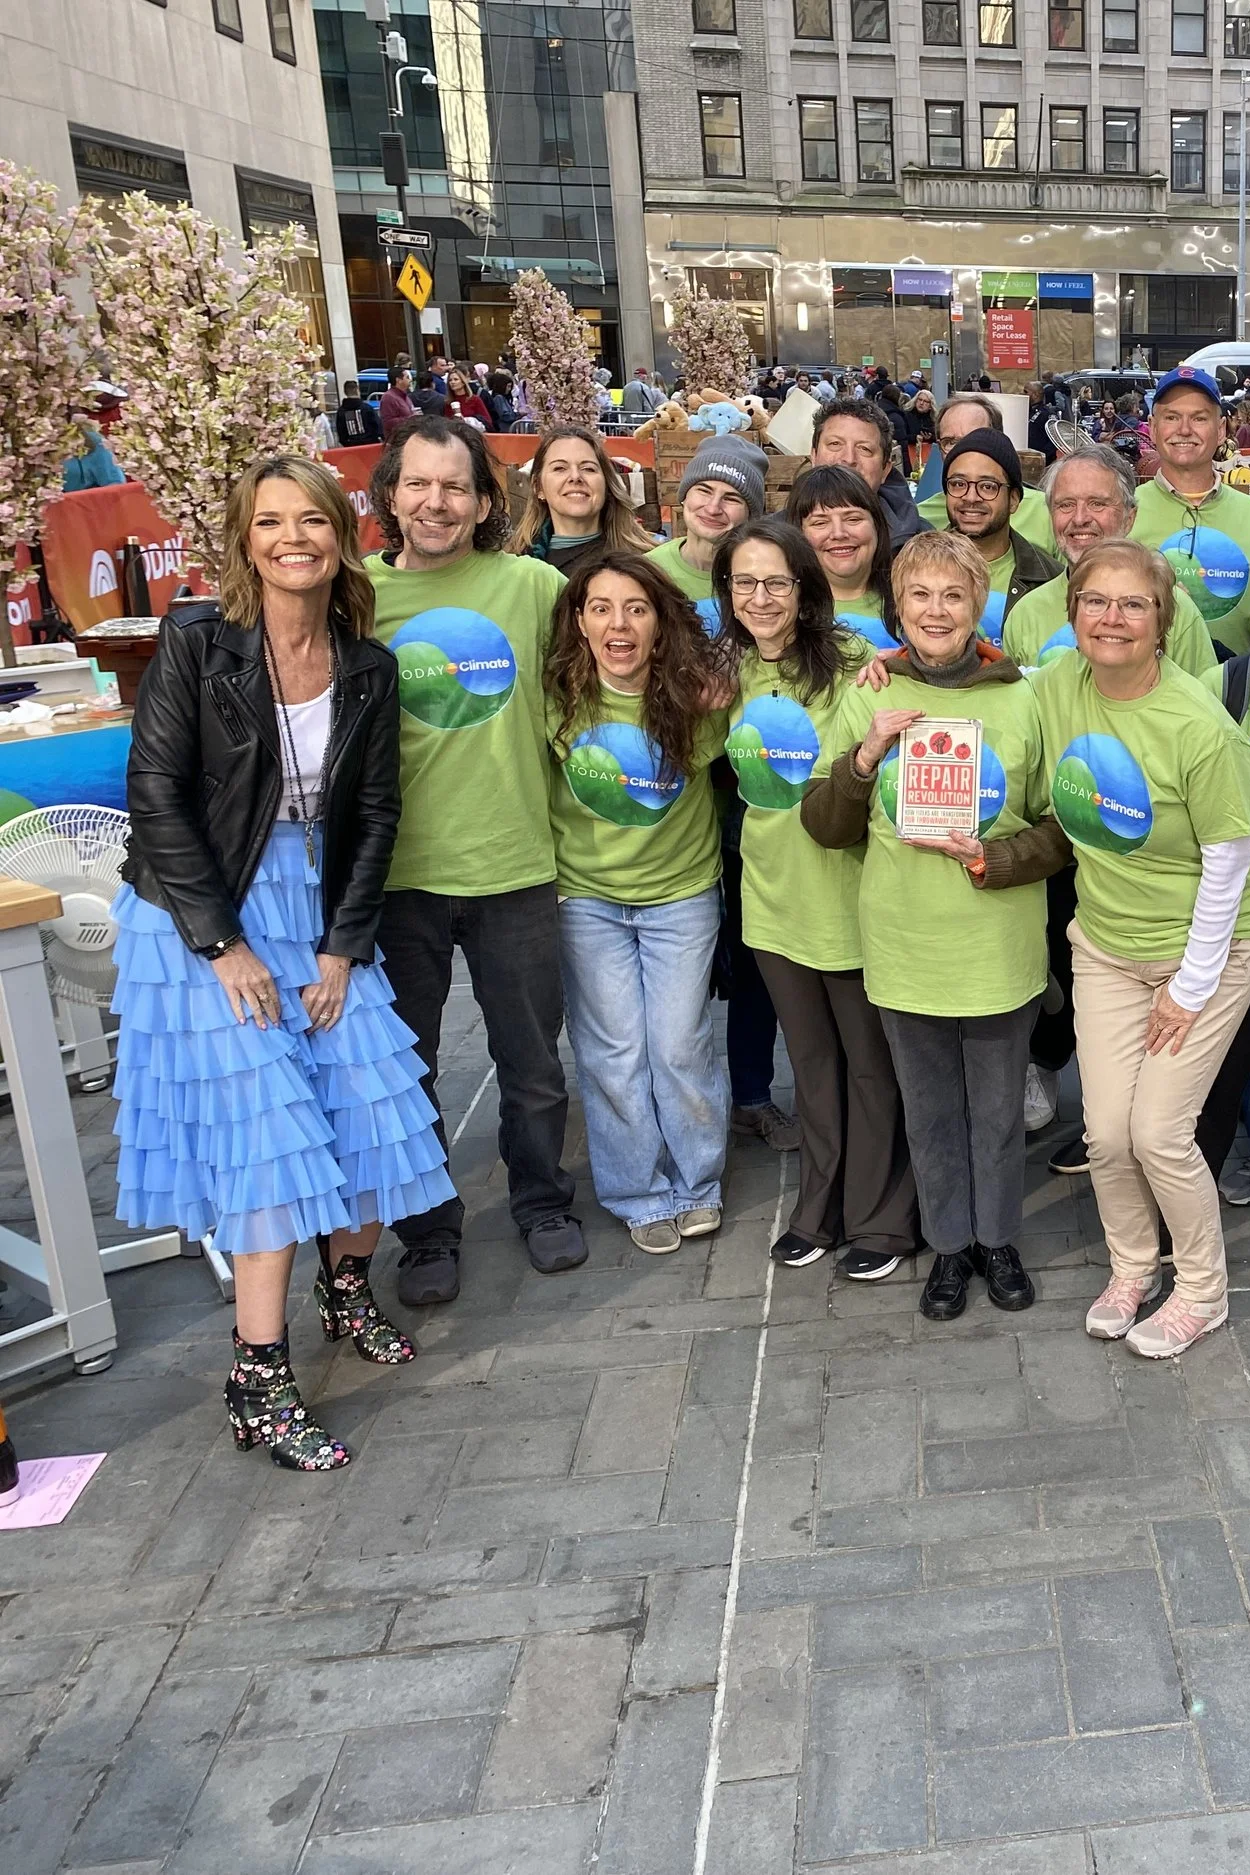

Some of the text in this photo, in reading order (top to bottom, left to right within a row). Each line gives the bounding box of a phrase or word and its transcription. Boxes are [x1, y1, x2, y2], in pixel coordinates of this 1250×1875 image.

[384, 232, 426, 244] ONE WAY
[992, 323, 1014, 331] Space
[708, 463, 746, 484] fieldkit
[1207, 568, 1245, 578] Climate
[401, 658, 510, 680] ODAY Climate
[728, 747, 813, 760] TODAY Climate
[570, 764, 617, 782] TODAY
[908, 765, 971, 791] REPAIR
[907, 790, 971, 805] REVOLUTION
[1057, 776, 1146, 819] TODAY Climate
